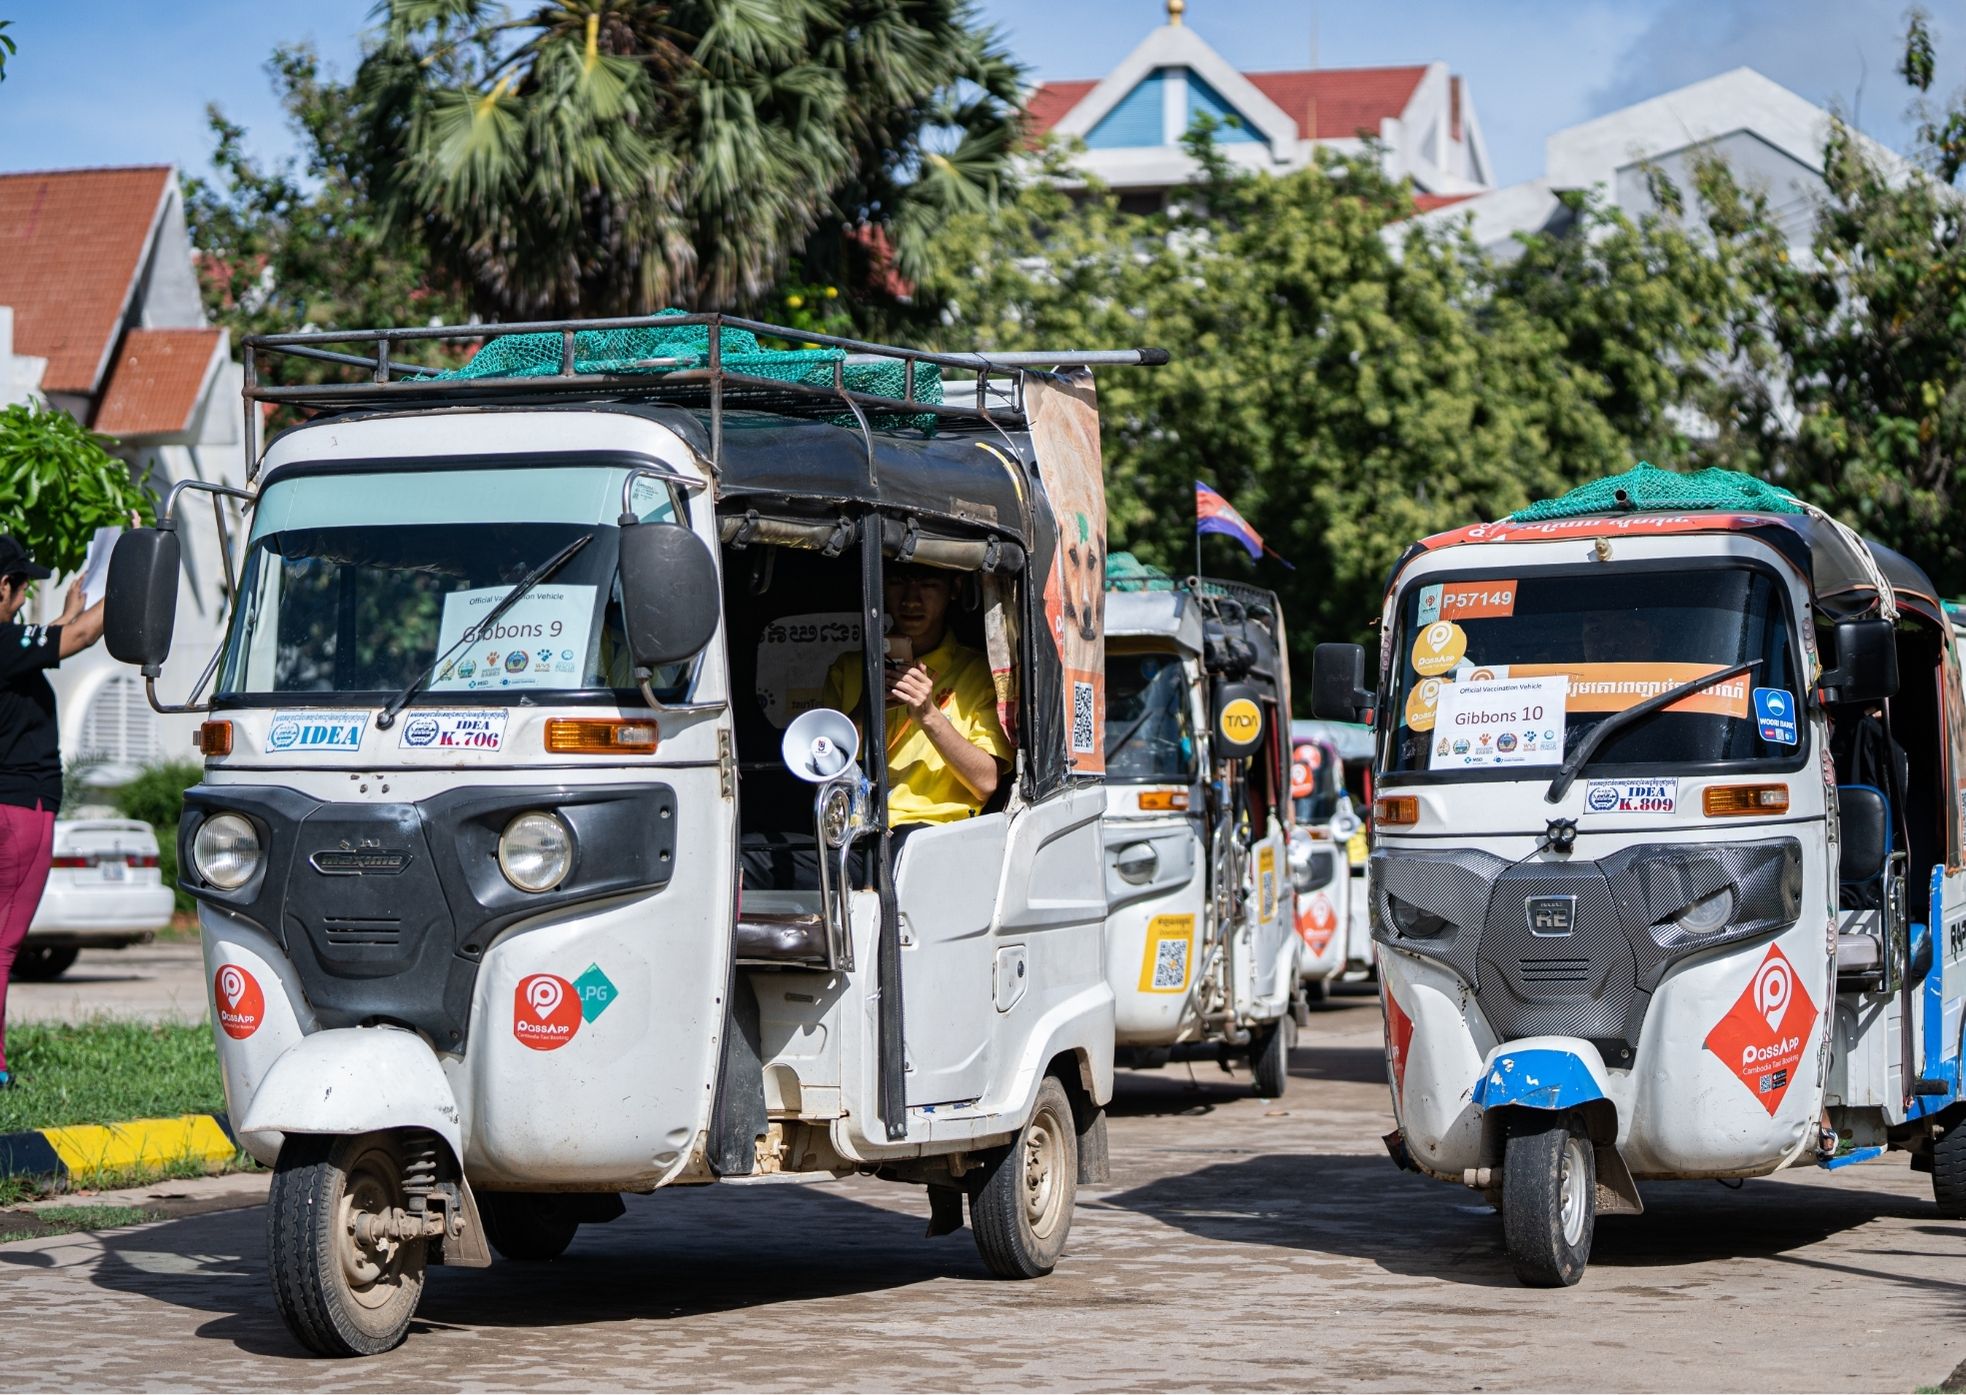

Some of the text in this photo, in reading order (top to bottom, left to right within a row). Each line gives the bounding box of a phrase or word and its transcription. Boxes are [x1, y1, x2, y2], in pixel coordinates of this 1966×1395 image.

[469, 595, 493, 606] Official
[537, 592, 564, 602] Vehicle
[1443, 591, 1512, 608] P57149
[463, 620, 563, 643] Gibbons 9
[1460, 683, 1542, 695] Official Vaccination Vehicle
[1455, 705, 1543, 726] Gibbons 10
[456, 720, 490, 730] IDEA
[1760, 717, 1794, 730] WOORI BANK
[299, 726, 358, 745] IDEA
[439, 731, 499, 748] K.706
[1627, 786, 1666, 797] IDEA
[1618, 797, 1674, 812] K.809
[1536, 908, 1568, 927] RE
[517, 1020, 570, 1034] PassApp
[1742, 1037, 1799, 1067] PassApp
[1743, 1062, 1772, 1076] Cambodia
